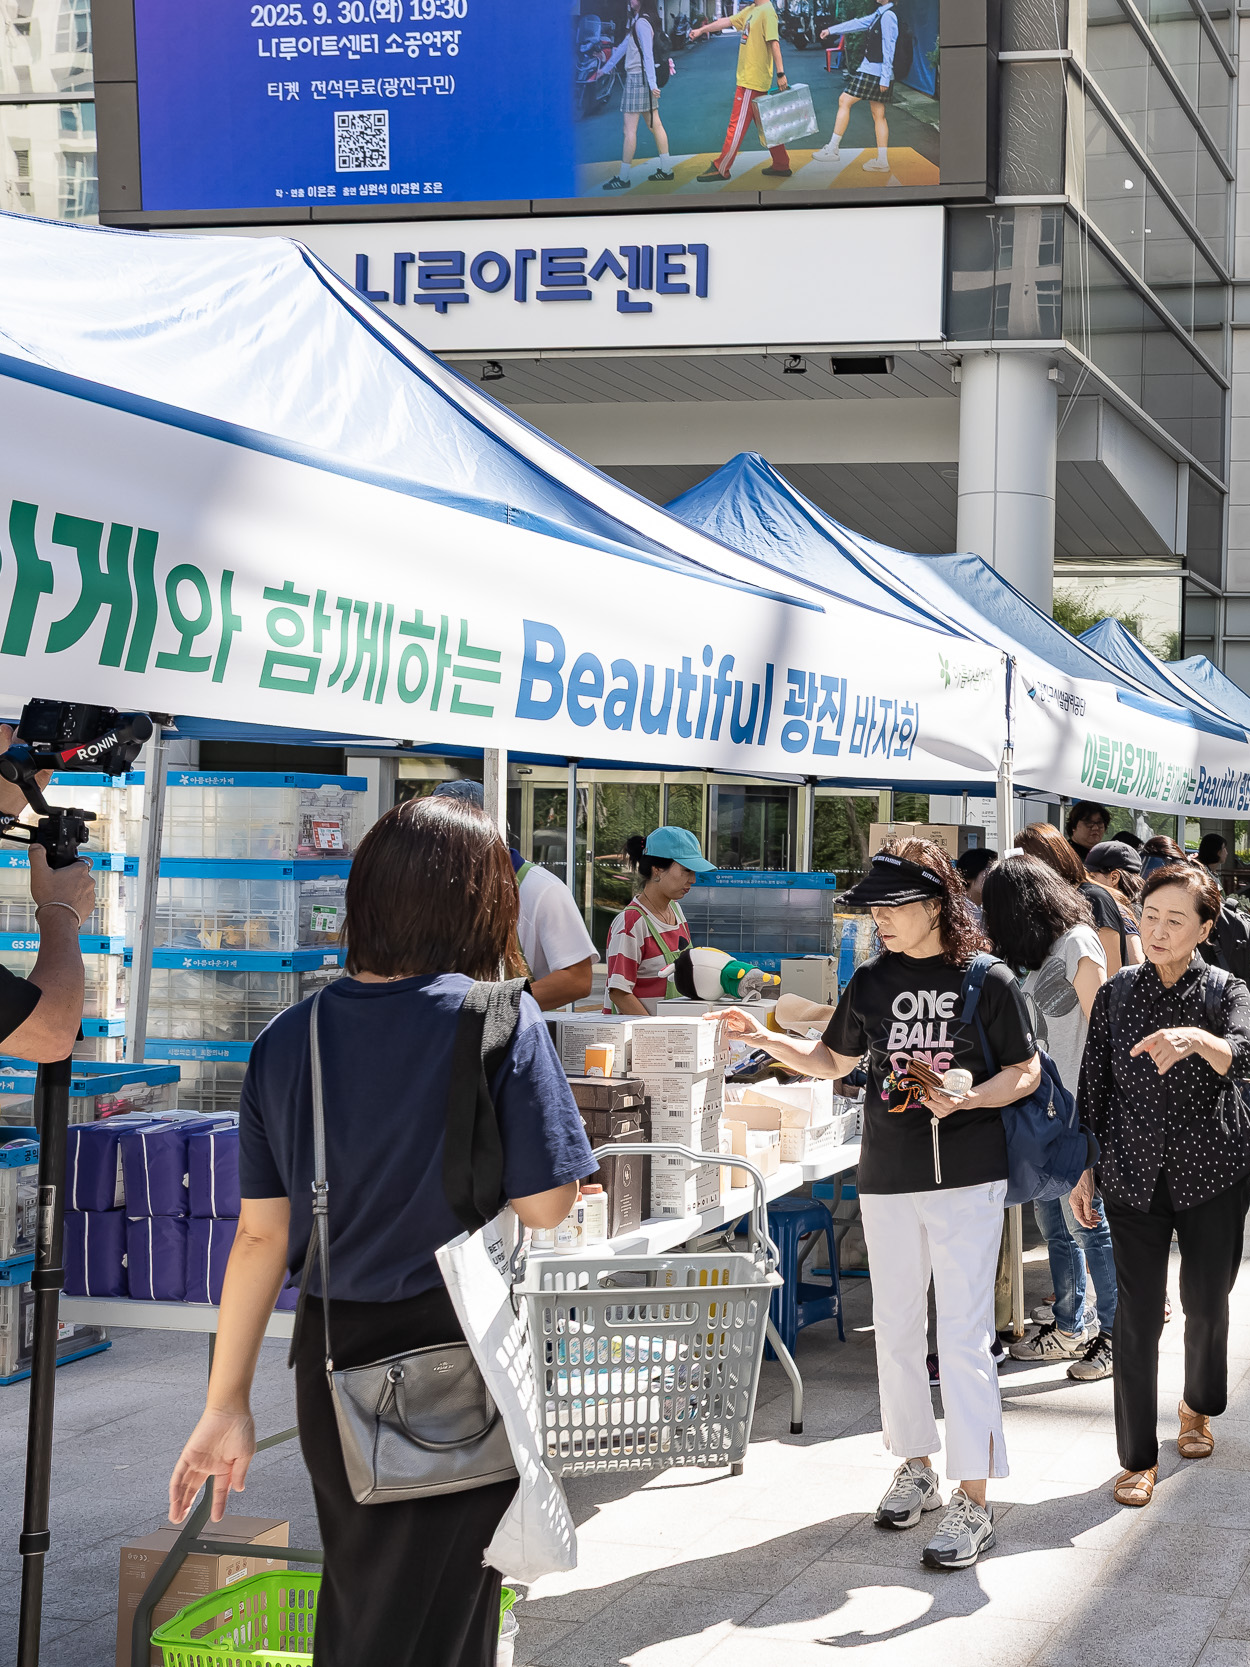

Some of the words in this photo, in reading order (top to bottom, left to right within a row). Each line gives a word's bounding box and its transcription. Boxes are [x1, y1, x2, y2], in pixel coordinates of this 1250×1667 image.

[250, 3, 307, 27] 2025.
[312, 2, 332, 25] 9.
[337, 0, 403, 24] 30.(화)
[409, 0, 468, 21] 19:30
[258, 34, 379, 60] 나루아트센터
[385, 30, 462, 58] 소공연장
[267, 81, 300, 101] 티켓
[311, 75, 455, 99] 전석무료(광진구민)
[307, 185, 336, 198] 이은준
[359, 183, 387, 196] 심원석
[390, 182, 420, 195] 이경원
[423, 181, 443, 194] 조은
[355, 243, 709, 314] 나루아트센터
[259, 580, 502, 718] 함께하는
[515, 619, 775, 746] Beautiful
[780, 668, 848, 757] 광진
[848, 694, 919, 761] 바자회
[76, 733, 118, 760] RONIN
[190, 777, 235, 785] 아름다운가게
[1081, 732, 1165, 801] 아름다운가게와
[1193, 765, 1243, 808] Beautiful
[192, 959, 238, 968] 아름다운가게
[892, 990, 959, 1020] ONE
[887, 1021, 955, 1050] BALL
